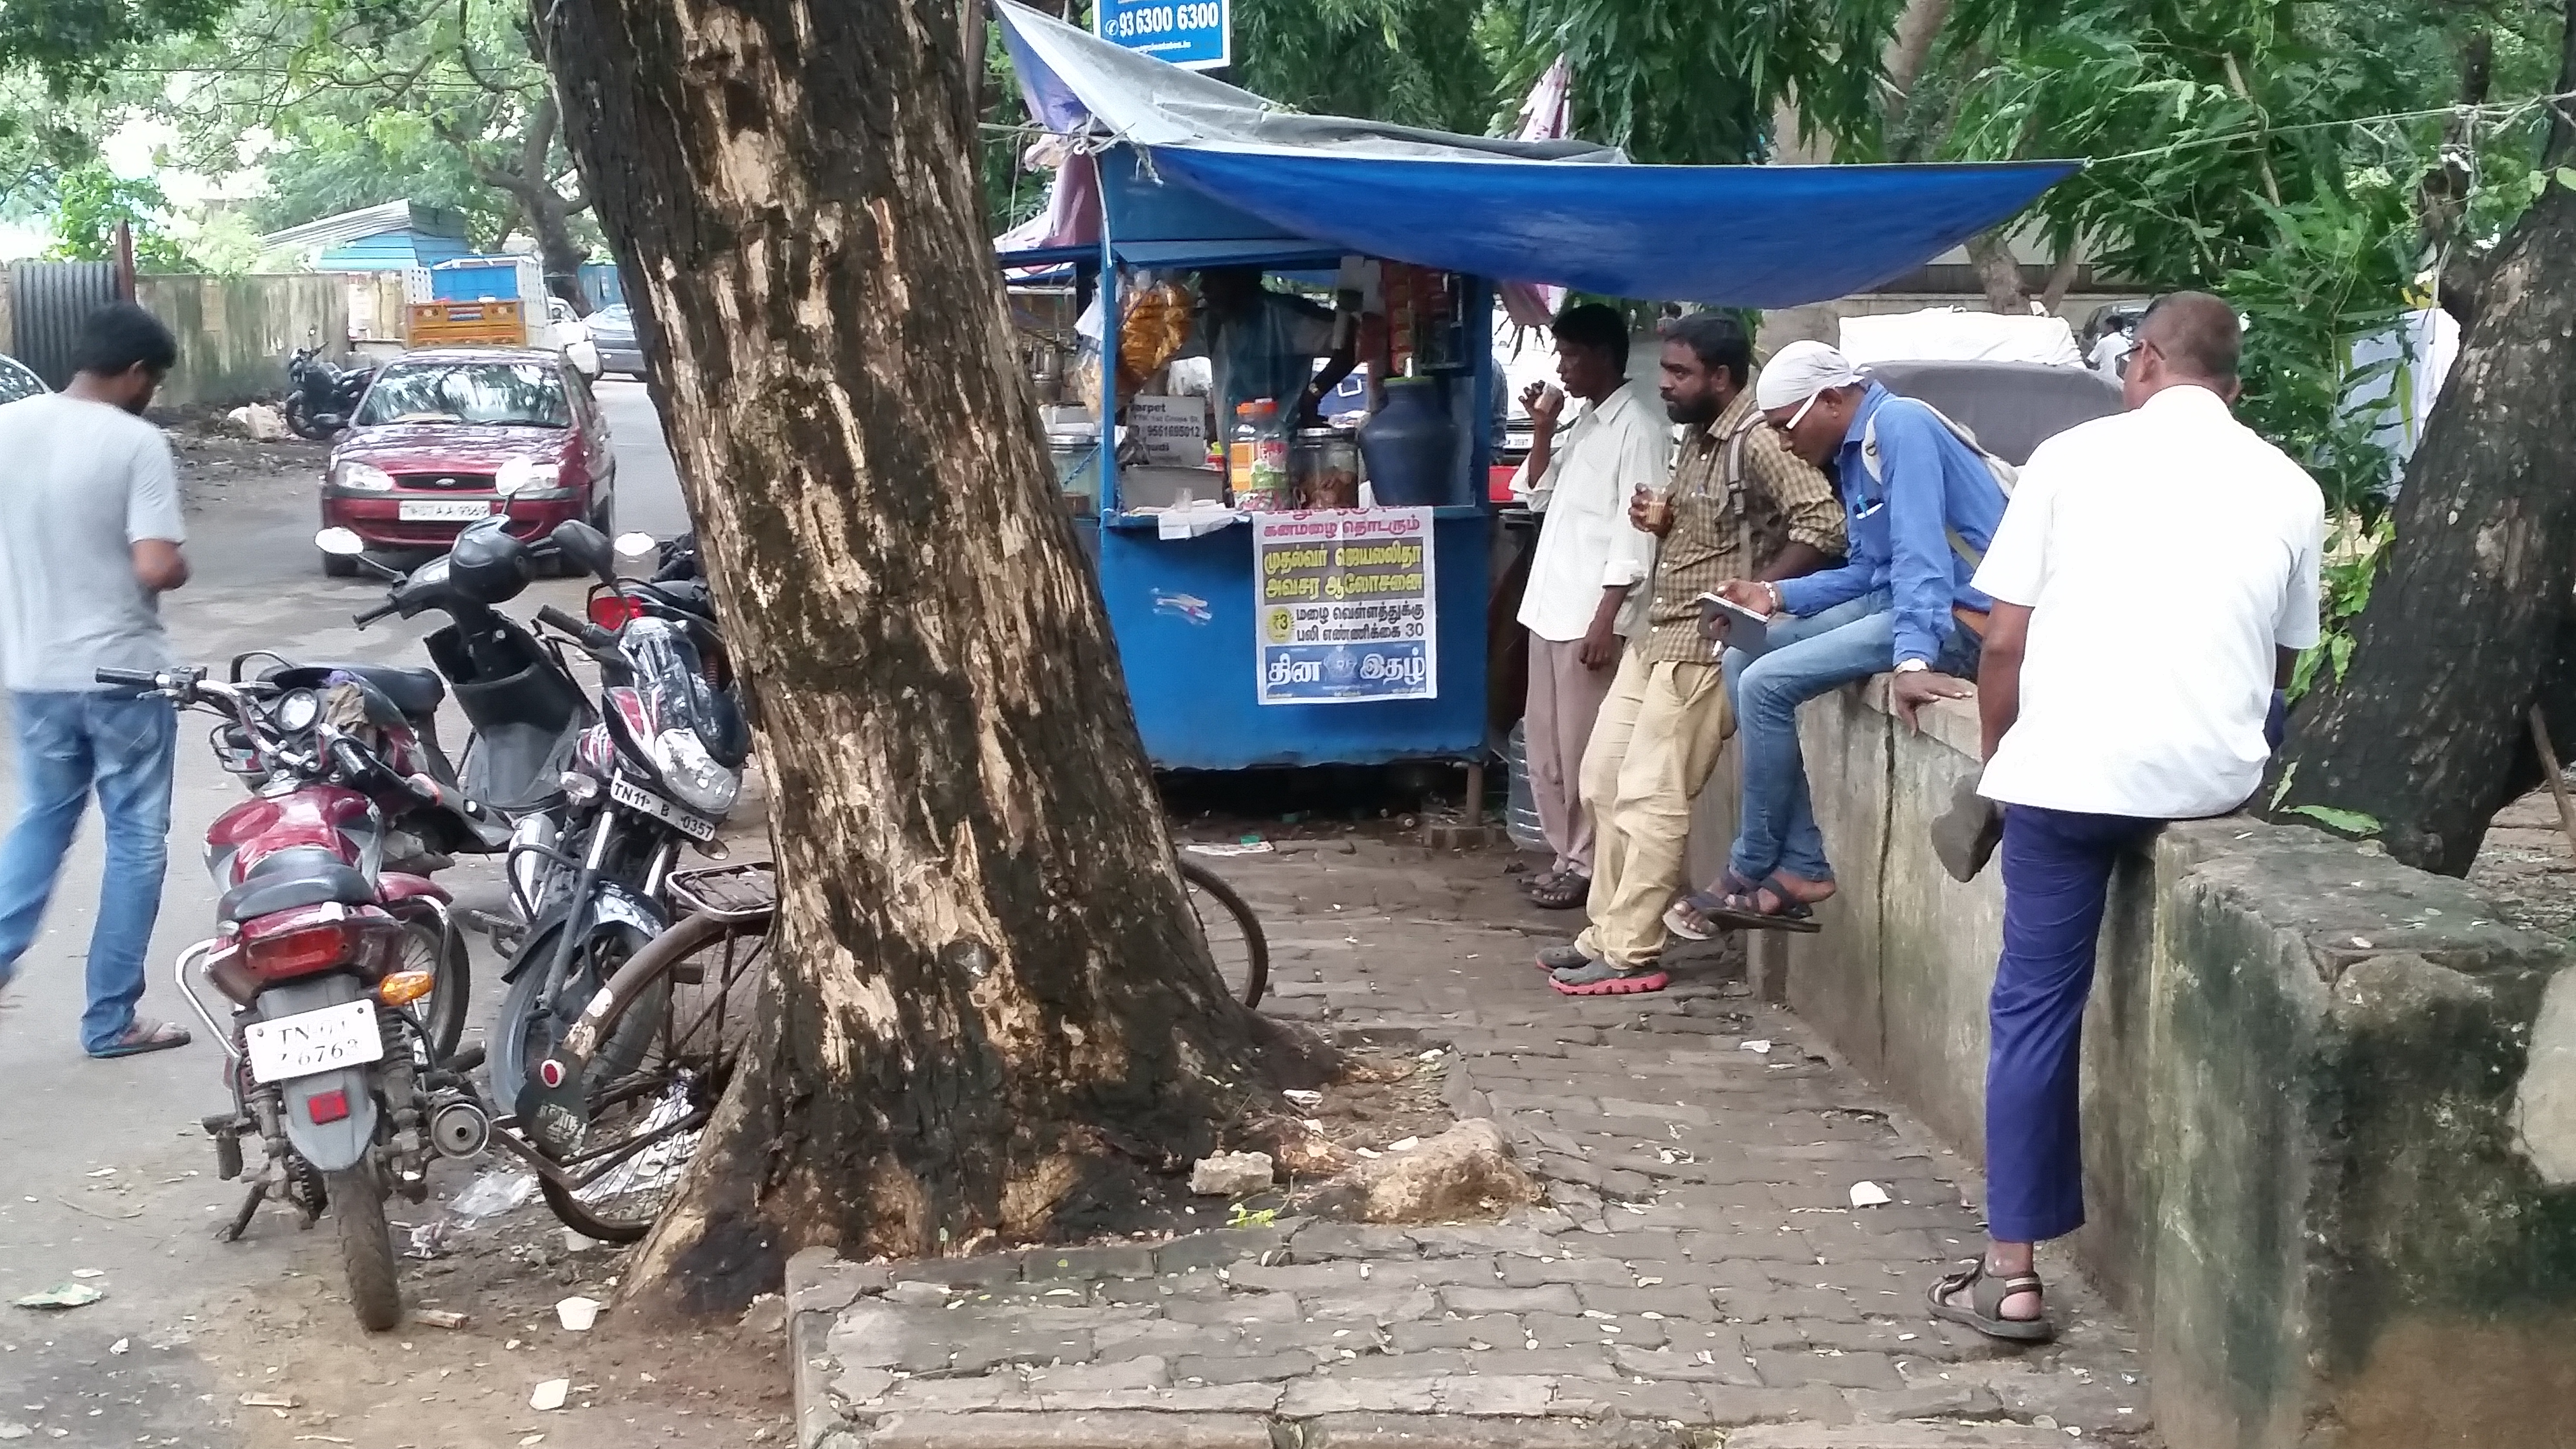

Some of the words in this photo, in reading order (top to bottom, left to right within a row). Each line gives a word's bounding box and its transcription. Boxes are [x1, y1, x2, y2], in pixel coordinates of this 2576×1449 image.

[1119, 11, 1134, 37] 93
[1136, 6, 1173, 33] 6300
[1177, 2, 1219, 30] 6300
[1264, 521, 1337, 538] கனமழை
[1343, 514, 1420, 536] தொடரும்
[1264, 544, 1328, 575] முதல்வர்
[1335, 540, 1422, 570] ஜெயலலிதா
[1265, 576, 1320, 600] அவசர
[1325, 572, 1423, 600] ஆலோசனை
[1296, 606, 1329, 625] மழை
[1333, 600, 1424, 625] வெள்ளத்துக்கு
[1297, 625, 1319, 642] பலி
[1323, 623, 1401, 641] எண்ணிக்கை
[1405, 623, 1424, 638] 30
[1267, 653, 1322, 689] தின
[1359, 647, 1426, 685] இதழ்
